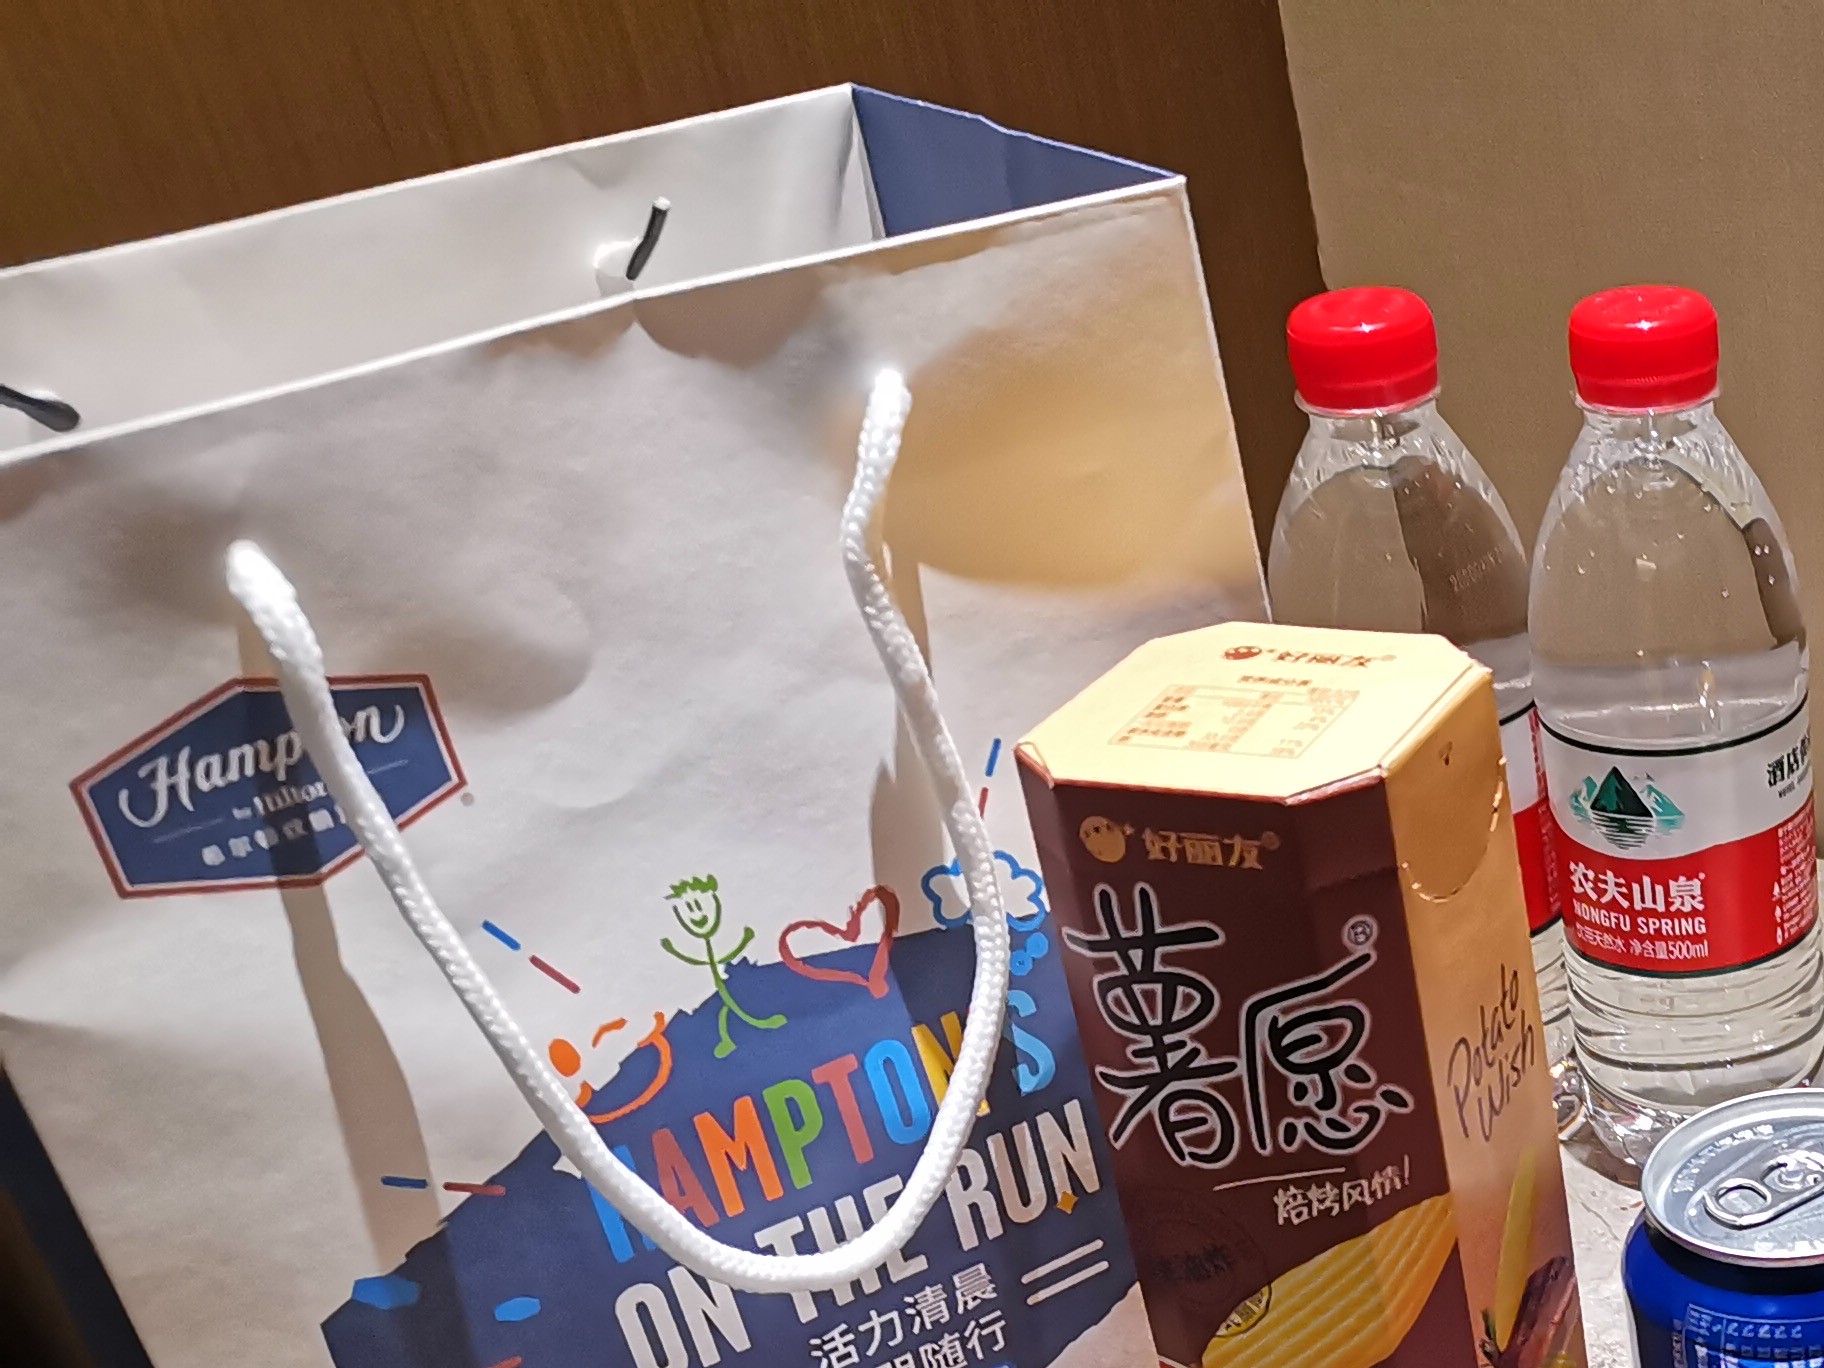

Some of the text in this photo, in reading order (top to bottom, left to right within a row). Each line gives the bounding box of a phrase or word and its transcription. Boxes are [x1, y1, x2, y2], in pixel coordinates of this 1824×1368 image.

[118, 704, 405, 829] Hampn
[1568, 860, 1706, 913] 农夫山泉
[1572, 898, 1708, 937] NONGFU SPRING
[944, 1098, 1101, 1253] RUN
